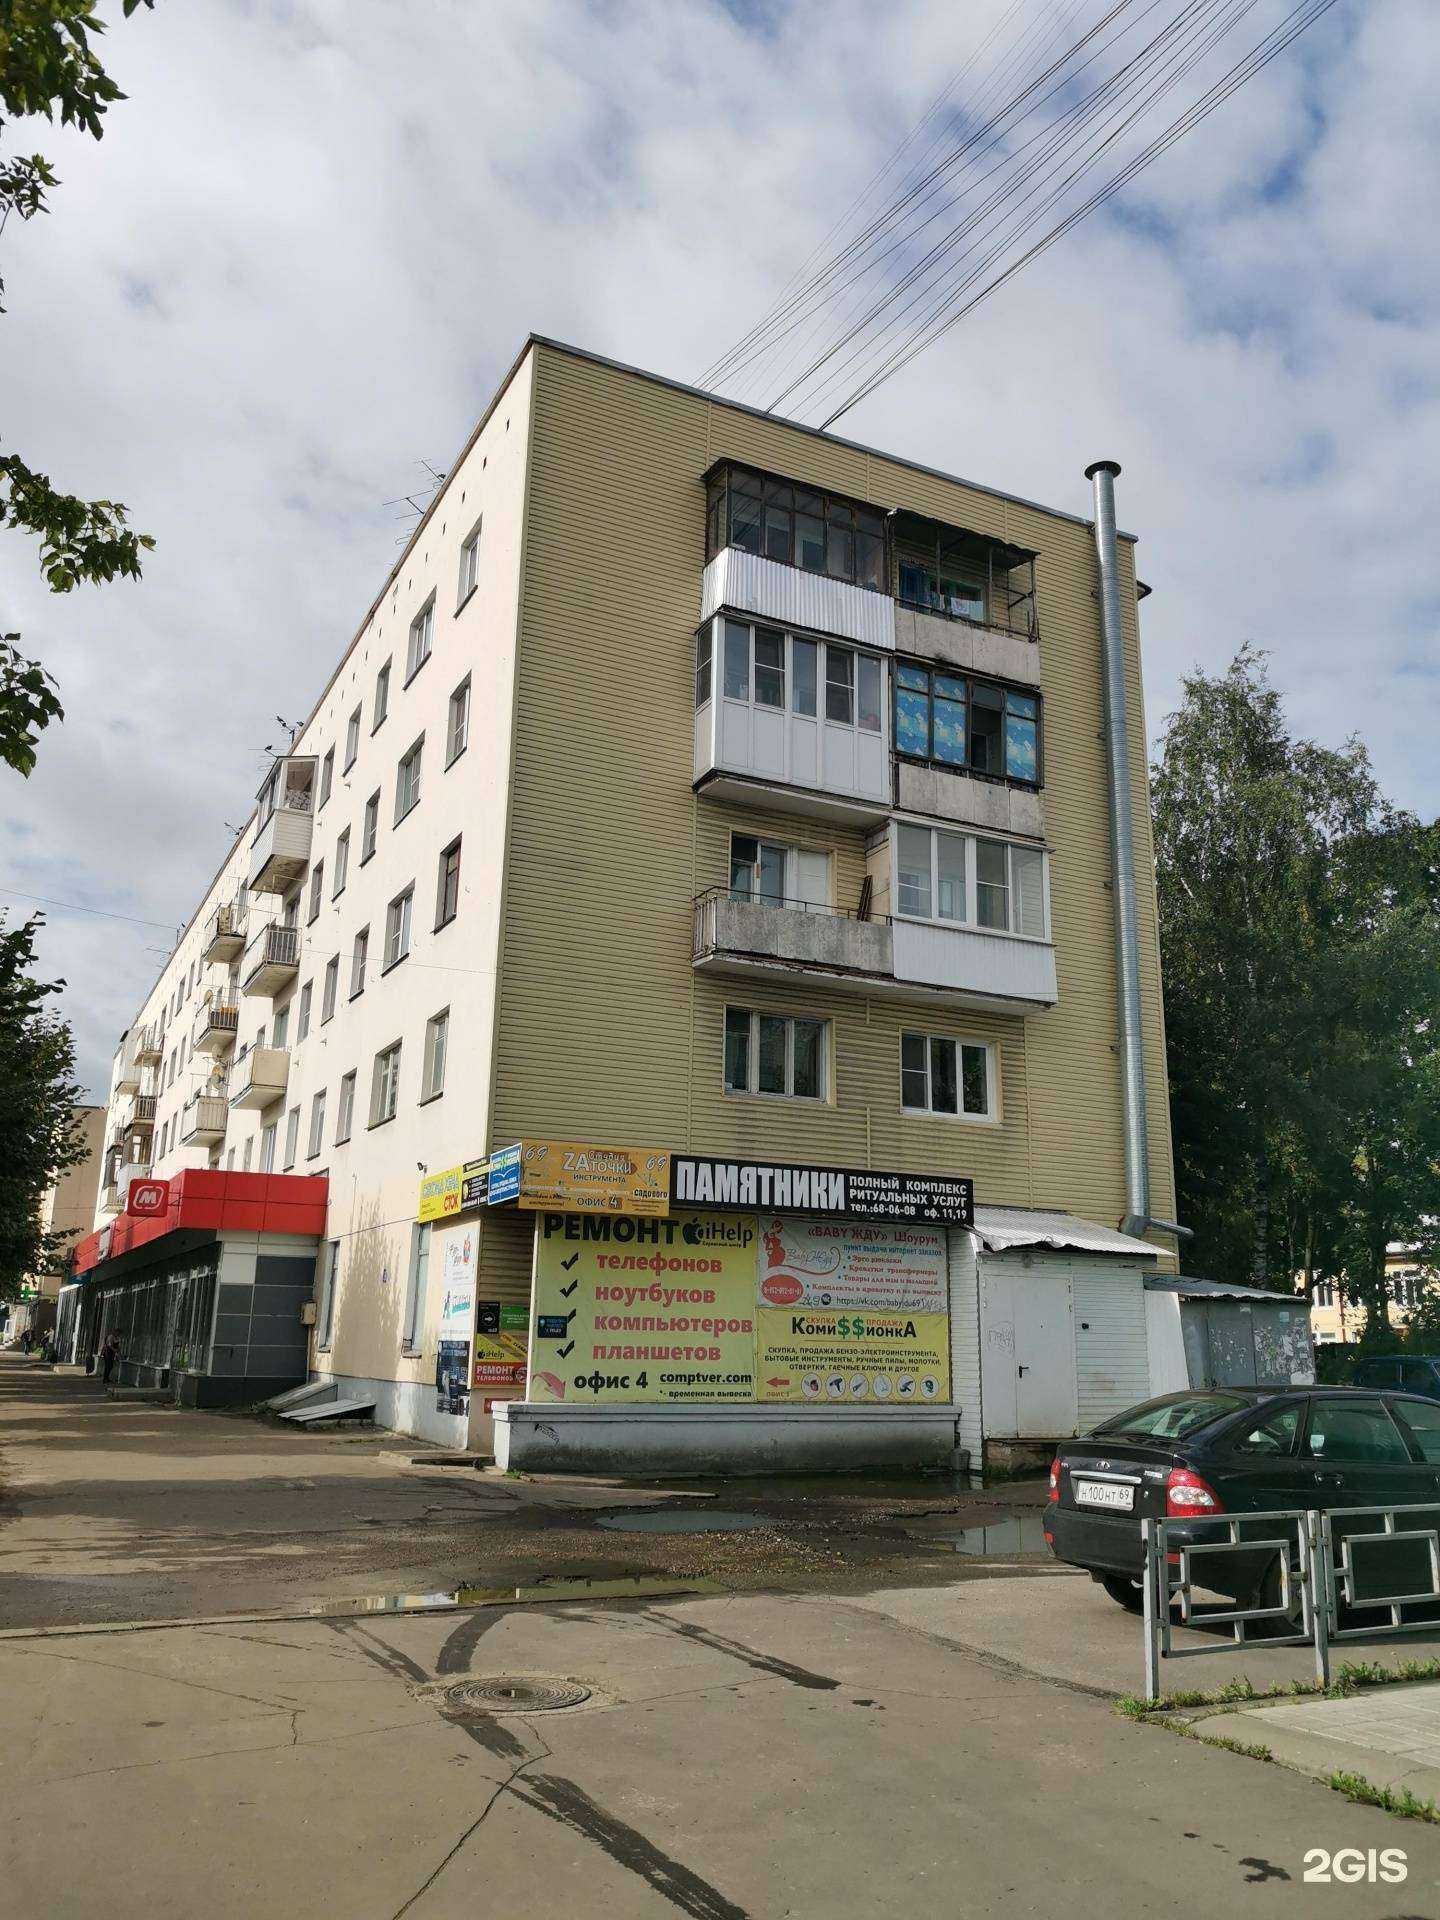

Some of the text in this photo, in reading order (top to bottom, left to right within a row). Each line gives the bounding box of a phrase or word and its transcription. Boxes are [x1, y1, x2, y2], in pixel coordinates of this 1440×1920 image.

[525, 1145, 548, 1161] 69
[573, 1172, 626, 1184] ИНСТРУМЕНТА
[676, 1160, 846, 1211] ПАМЯТНИКИ
[849, 1175, 967, 1195] ПОЛНЫЙ КОМПЛЕКС
[576, 1197, 606, 1208] ОФИС
[849, 1188, 967, 1208] РИТУАЛЬНЫХ УСЛУГ
[850, 1202, 967, 1220] тел.:68-06-08 оф. 11,19
[543, 1214, 680, 1245] РЕМОНТ
[705, 1221, 753, 1249] iHelp
[894, 1231, 938, 1245] Шоурум
[596, 1251, 723, 1276] телефонов
[595, 1282, 717, 1307] ноутбуков
[594, 1315, 754, 1338] компьютеров
[592, 1343, 721, 1361] планшетов
[764, 1354, 800, 1362] БЫТОВЫЕ
[800, 1347, 835, 1355] ПРОДАЖА
[476, 1365, 514, 1374] РЕМОНТ
[862, 1365, 887, 1373] КЛЮЧИ
[573, 1370, 649, 1394] офис 4
[659, 1372, 753, 1386] comptver.com
[668, 1390, 716, 1398] временная
[717, 1390, 752, 1398] вывеска
